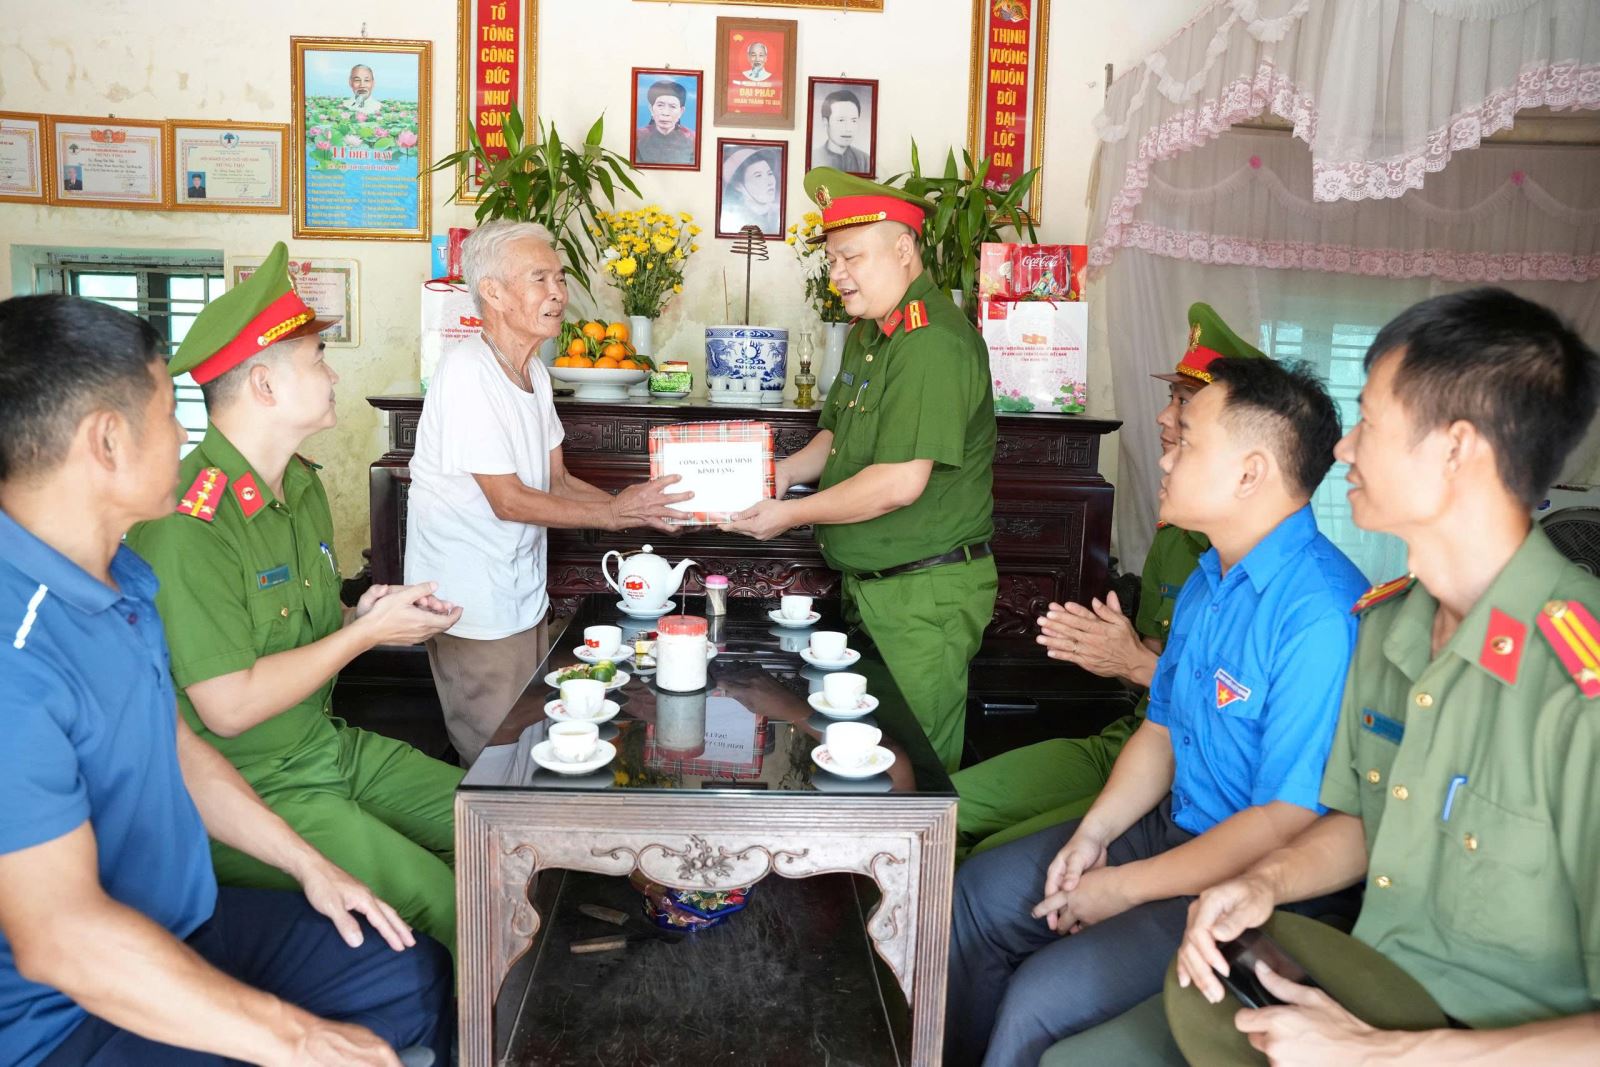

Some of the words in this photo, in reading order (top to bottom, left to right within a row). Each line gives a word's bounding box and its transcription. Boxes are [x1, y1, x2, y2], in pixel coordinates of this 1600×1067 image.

[490, 1, 506, 20] TỔ
[482, 24, 514, 42] TÔNG
[992, 28, 1026, 46] THỊNH
[481, 45, 514, 63] CÔNG
[990, 47, 1027, 66] VƯỢNG
[485, 66, 510, 84] ĐỨC
[990, 68, 1024, 86] MUÔN
[484, 89, 510, 106] NHƯ
[997, 88, 1016, 106] ĐỜI
[995, 111, 1016, 128] ĐẠI
[993, 130, 1015, 148] LỘC
[993, 152, 1013, 167] GIA
